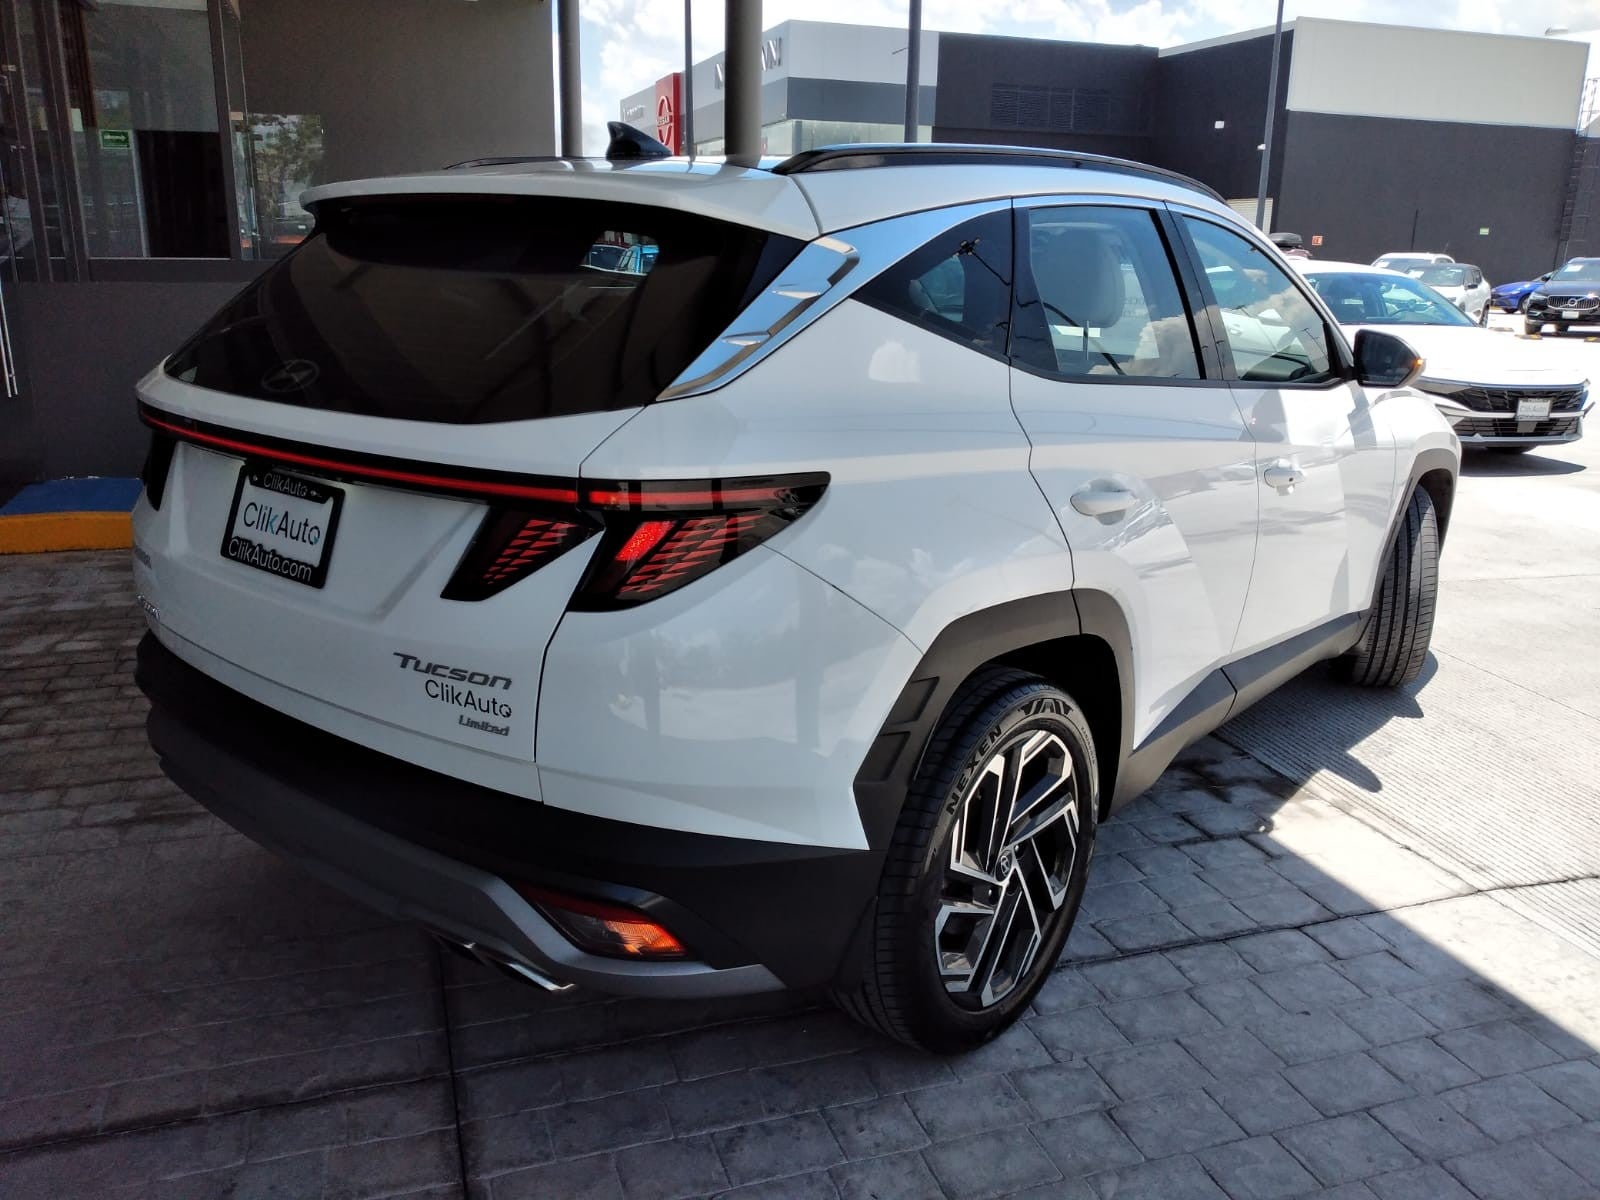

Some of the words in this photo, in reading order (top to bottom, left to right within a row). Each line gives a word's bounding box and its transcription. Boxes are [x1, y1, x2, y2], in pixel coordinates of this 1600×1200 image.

[263, 472, 308, 497] ClikAuto
[243, 502, 320, 546] ClikAuto
[228, 538, 312, 582] ClikAuto.com
[425, 679, 512, 718] ClikAuto
[458, 714, 510, 737] Limited
[946, 725, 1003, 815] NEXEN
